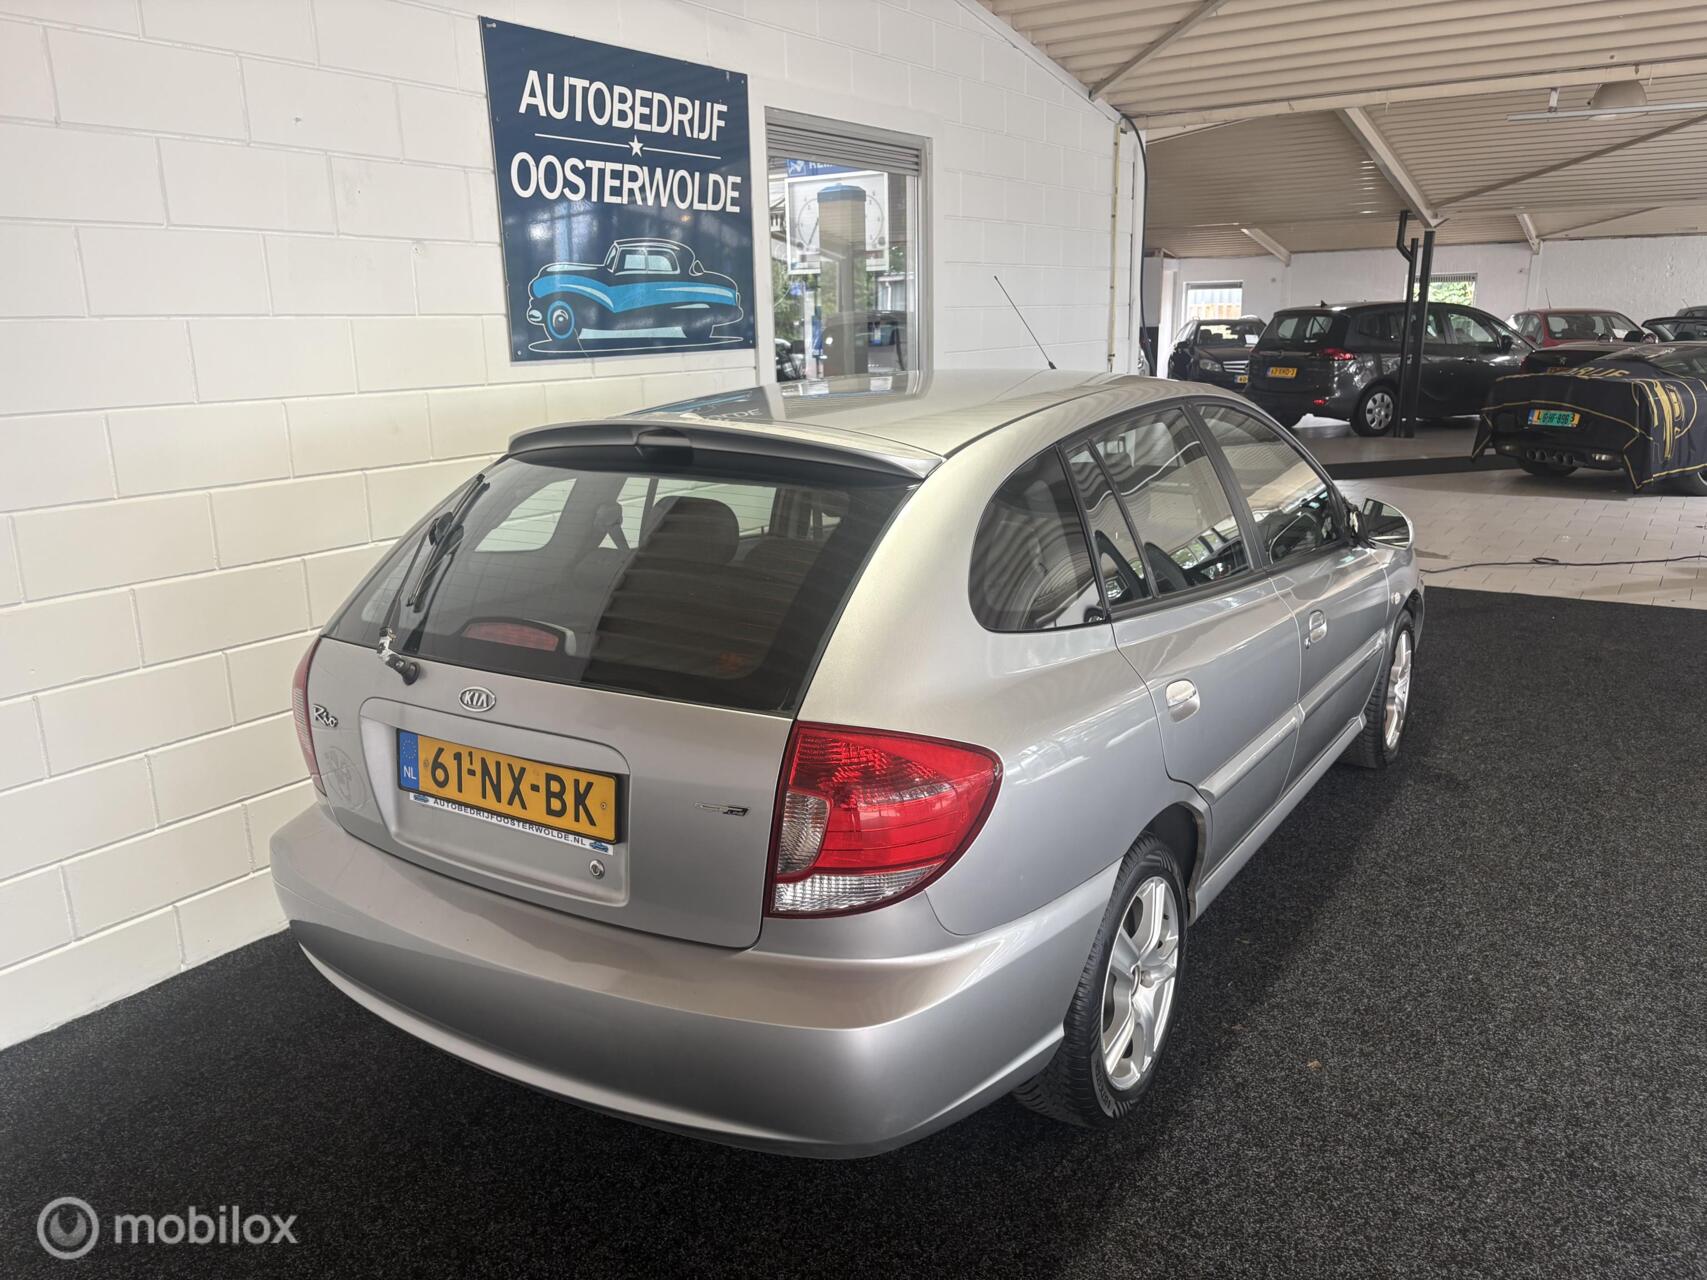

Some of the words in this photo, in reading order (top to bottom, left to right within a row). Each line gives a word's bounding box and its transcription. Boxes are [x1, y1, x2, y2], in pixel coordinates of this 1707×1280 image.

[518, 70, 728, 141] AUTOBEDRIJF
[510, 151, 742, 213] OOSTERWOLDE
[313, 703, 338, 728] Rio
[403, 765, 417, 780] NL
[433, 798, 586, 846] AUTOBEDRIJFOOSTERWOLDE.NL
